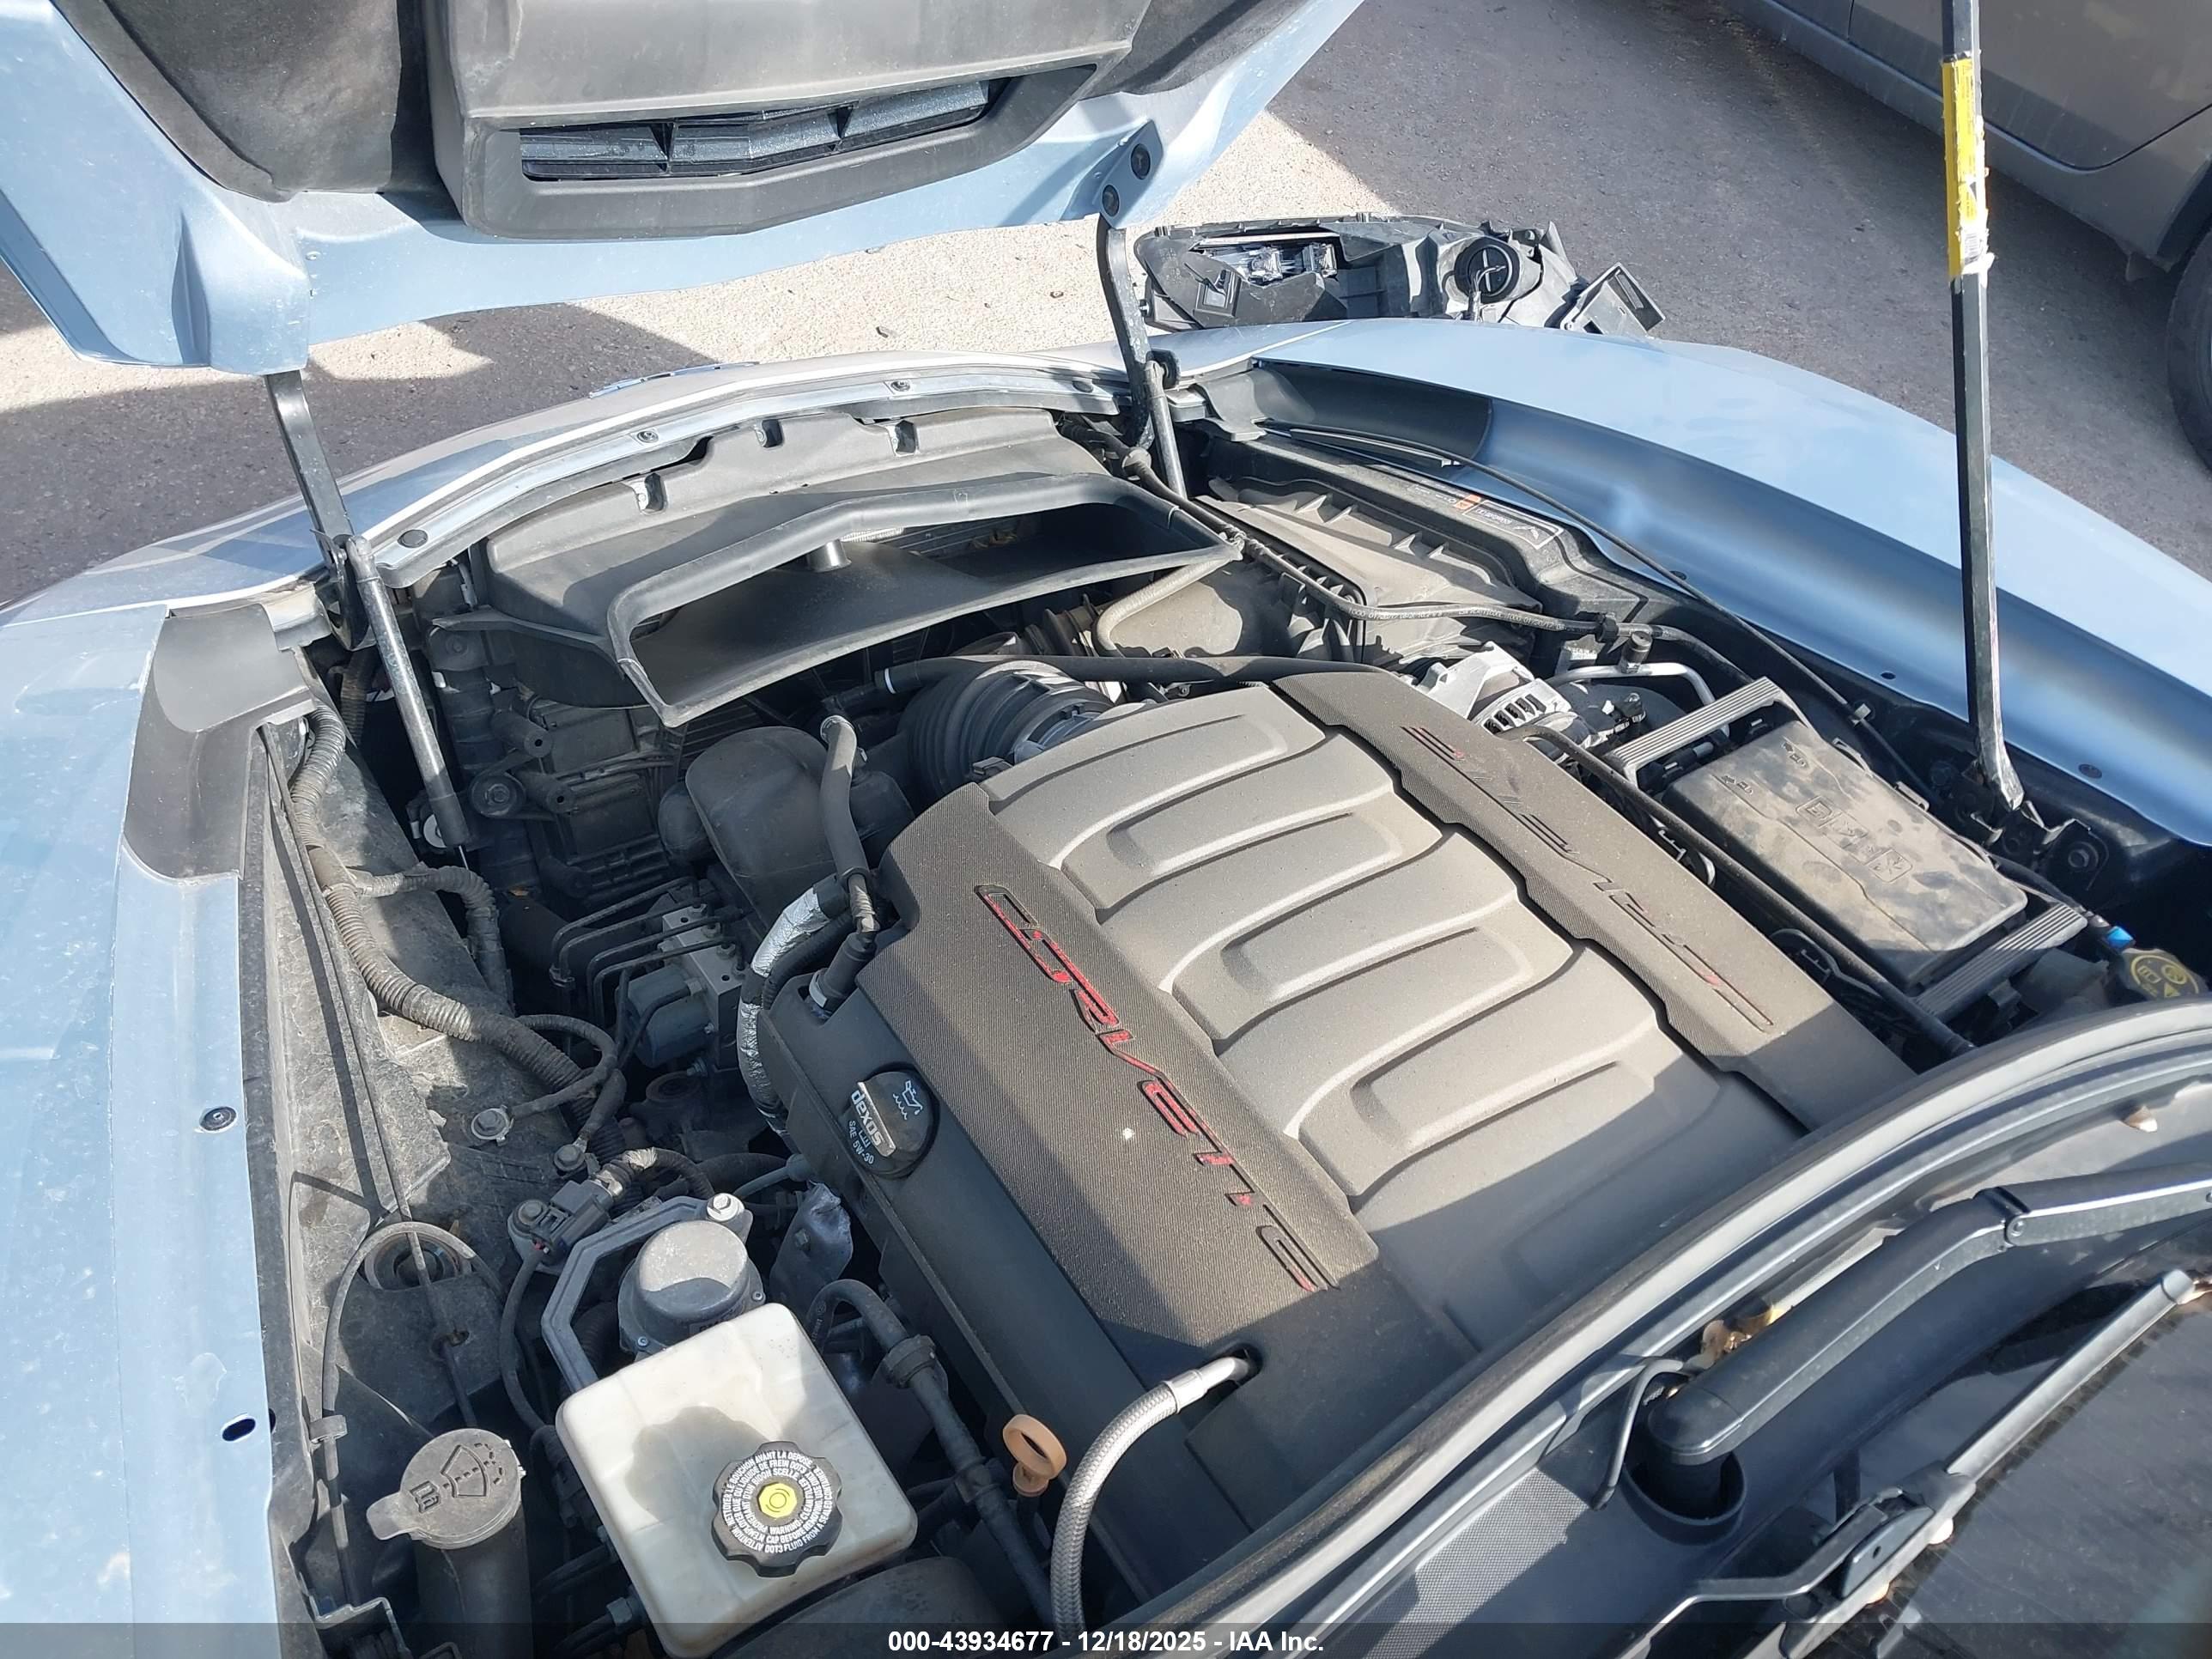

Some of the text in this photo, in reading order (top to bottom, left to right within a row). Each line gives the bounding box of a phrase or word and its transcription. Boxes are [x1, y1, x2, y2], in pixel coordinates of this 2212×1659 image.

[974, 884, 1340, 1292] CORVETTE
[851, 1090, 884, 1146] dexos
[849, 1120, 875, 1164] SAE 5W-30
[753, 1450, 775, 1463] AVANT
[777, 1450, 787, 1459] LA
[728, 1456, 755, 1484] BOUCHON
[757, 1461, 769, 1470] DE
[769, 1459, 789, 1468] FREIN
[789, 1460, 807, 1474] DOT3
[738, 1464, 760, 1487] LIQUIDE
[750, 1468, 772, 1485] BIDON
[804, 1470, 818, 1486] ONLY
[725, 1482, 734, 1492] LE
[733, 1486, 743, 1497] DU
[797, 1476, 813, 1498] FILLER
[812, 1485, 823, 1498] USE
[721, 1492, 737, 1526] NETTOYER
[732, 1498, 741, 1511] QUE
[799, 1499, 813, 1521] CLEAN
[740, 1500, 768, 1534] PROVENANT
[763, 1544, 782, 1553] DOT3
[783, 1539, 804, 1552] FLUID
[801, 1526, 820, 1544] FROM
[817, 1500, 832, 1524] SEALED
[765, 1534, 778, 1544] CAP
[780, 1527, 806, 1543] BEFORE
